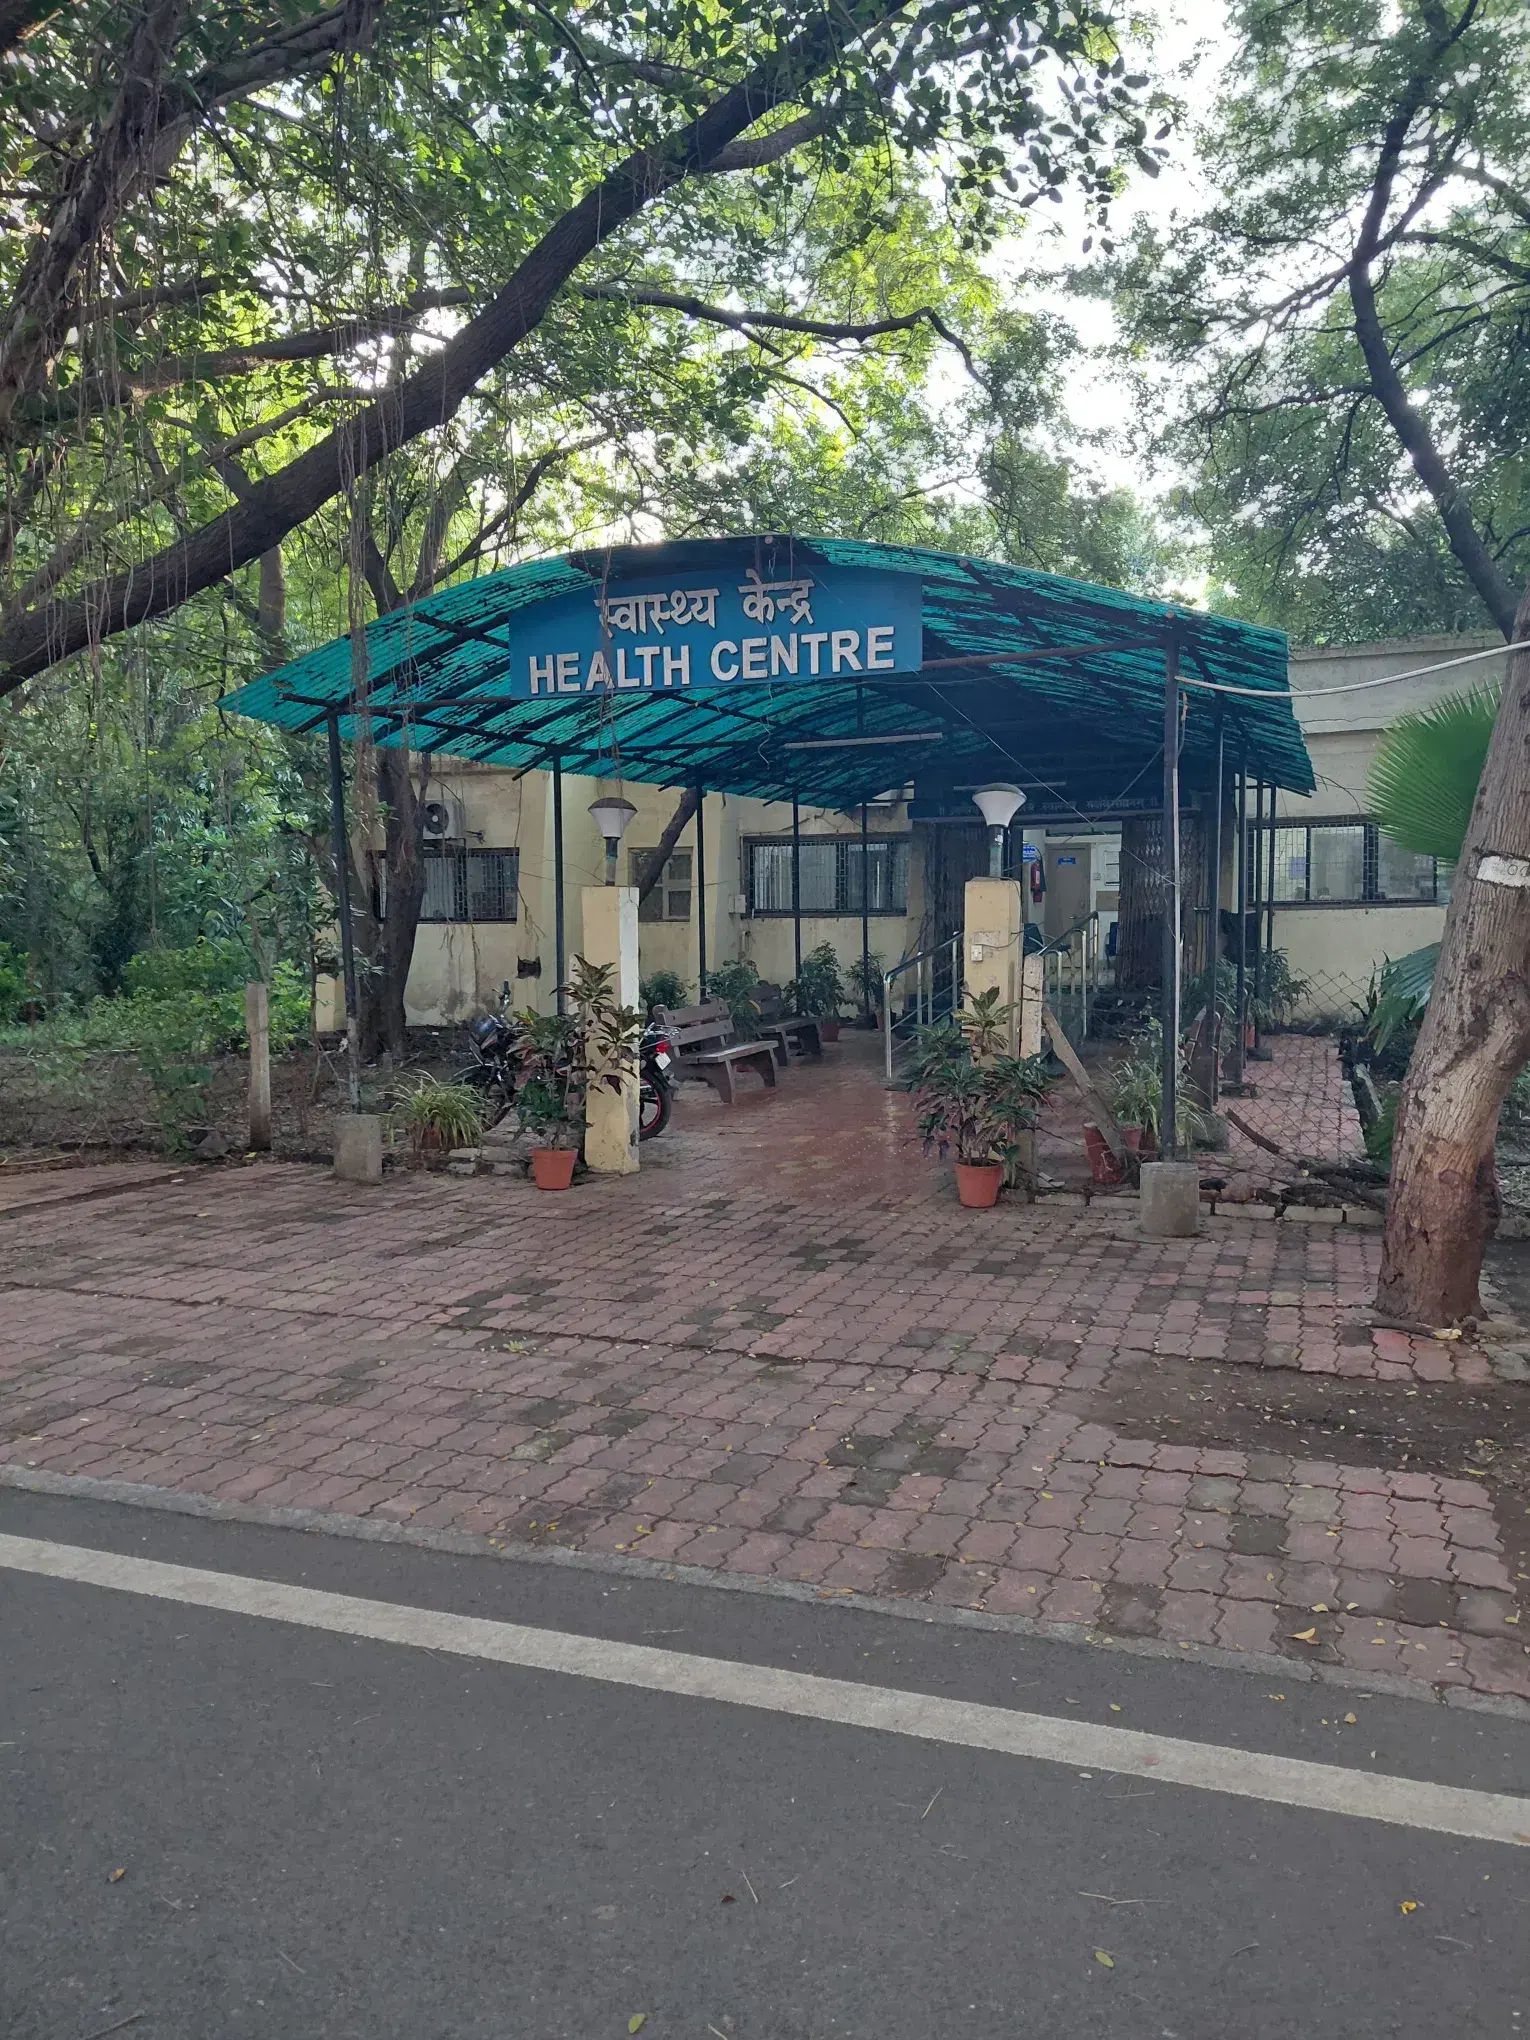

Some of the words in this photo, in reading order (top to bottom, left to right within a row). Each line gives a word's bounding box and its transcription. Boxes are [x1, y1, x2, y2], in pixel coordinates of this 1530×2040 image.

[594, 588, 720, 638] स्वास्थ्य
[738, 568, 815, 625] केन्द्र
[528, 645, 690, 694] HEALTH
[710, 626, 896, 681] CENTRE
